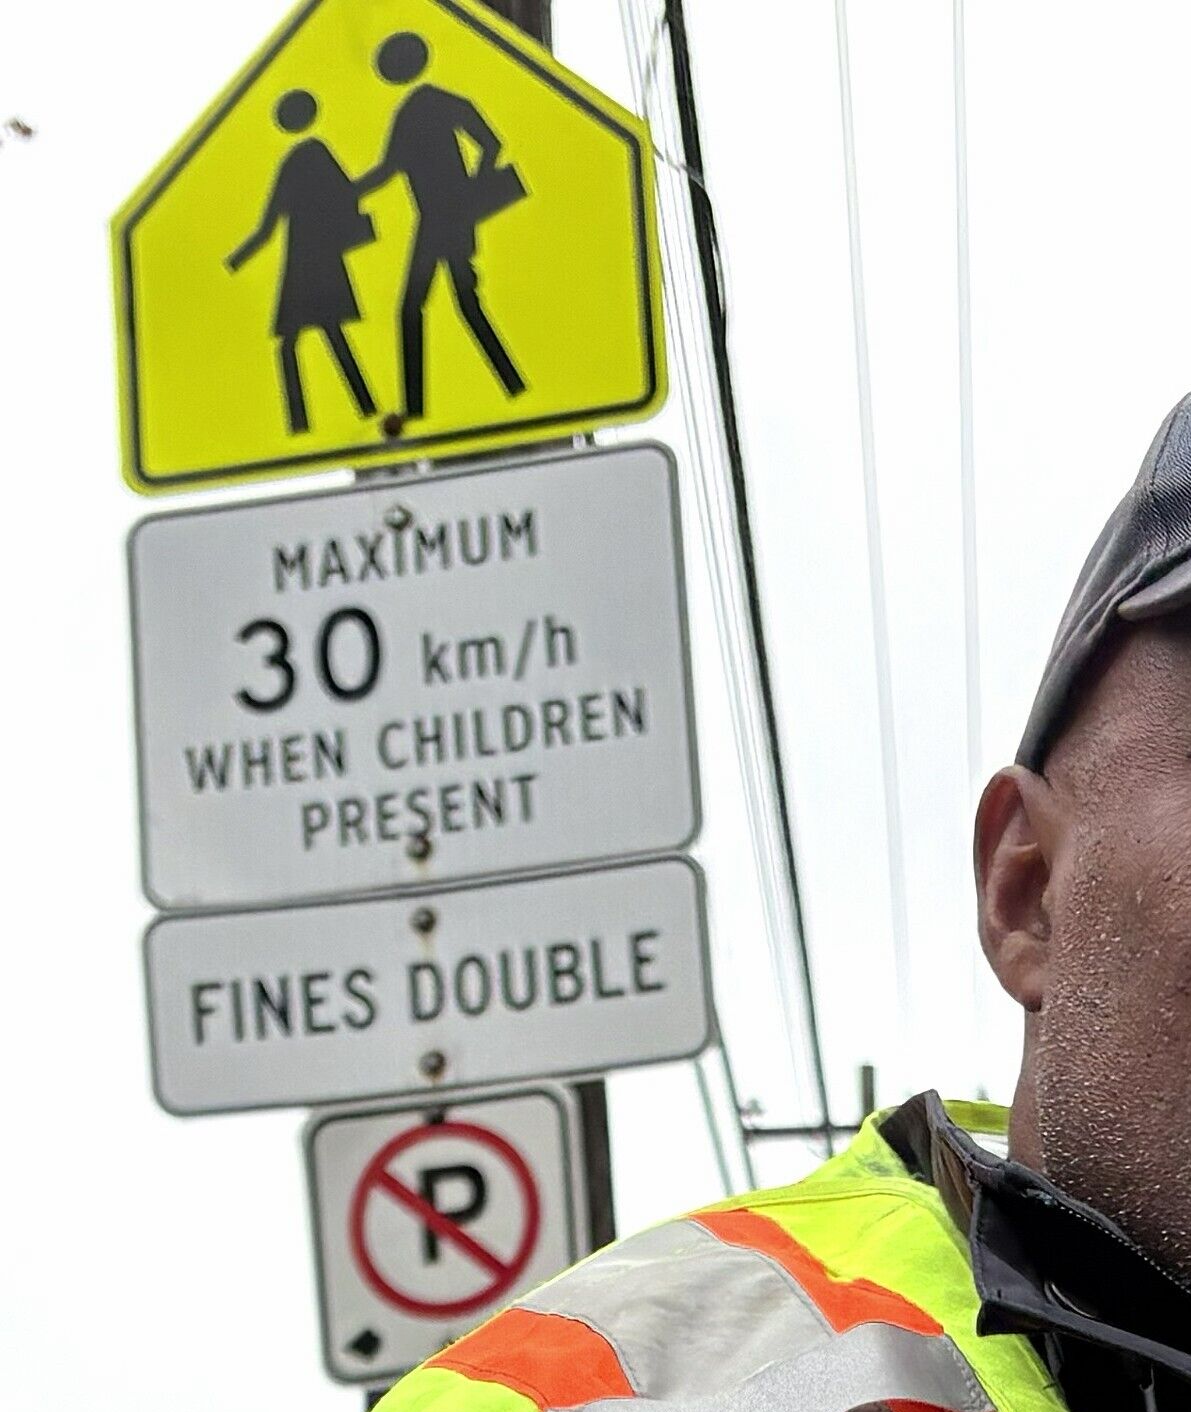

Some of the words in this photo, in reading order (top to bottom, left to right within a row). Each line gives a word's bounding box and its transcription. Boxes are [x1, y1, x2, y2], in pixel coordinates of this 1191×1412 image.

[273, 509, 539, 593] MAXIMUM
[234, 606, 383, 714] 30
[420, 614, 577, 685] km/h
[185, 730, 348, 794] WHEN
[377, 688, 650, 771] CHILDREN
[302, 773, 538, 850] PRESENT
[191, 968, 378, 1046] FINES
[409, 929, 666, 1024] DOUBLE
[418, 1163, 488, 1266] P
